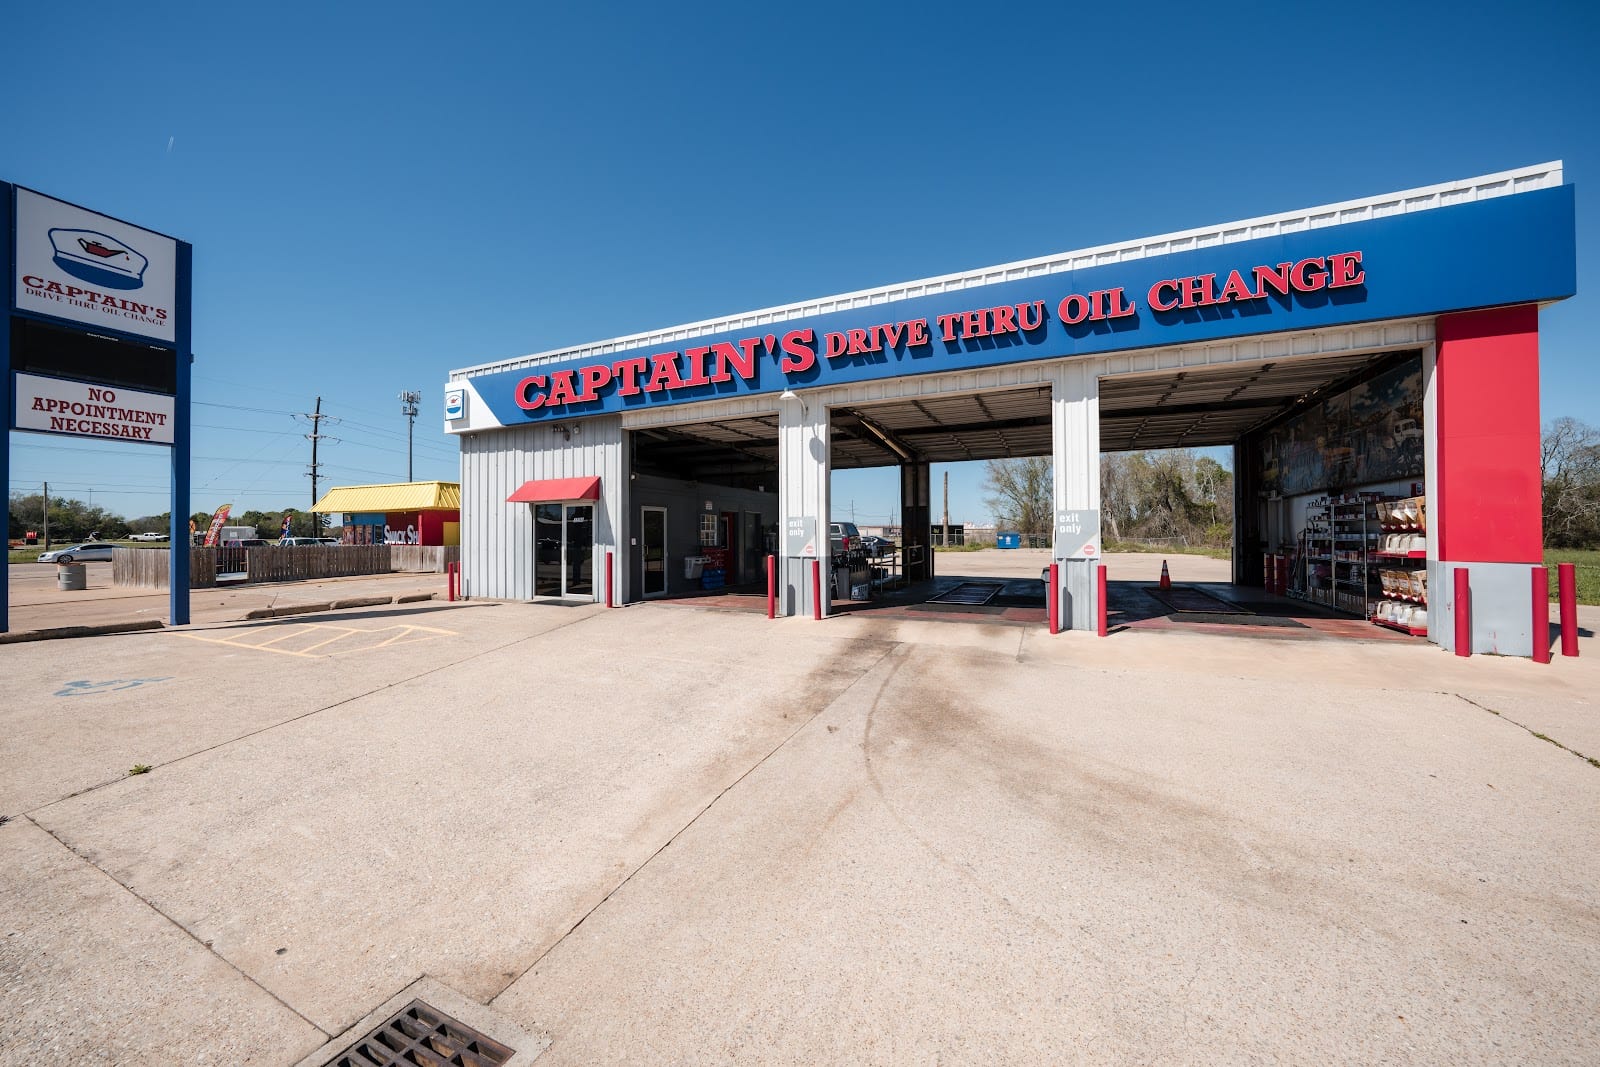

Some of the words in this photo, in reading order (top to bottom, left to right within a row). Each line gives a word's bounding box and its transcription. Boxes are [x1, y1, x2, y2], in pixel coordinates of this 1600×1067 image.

[22, 275, 168, 320] CAPTAIN'S
[26, 287, 64, 303] DRIVE
[68, 298, 98, 311] THRU
[102, 306, 121, 317] OIL
[124, 312, 166, 327] CHANGE
[515, 328, 816, 410] CAPTAIN'S
[823, 318, 928, 358] DRIVE
[937, 300, 1045, 341] THRU
[1057, 287, 1136, 325] OIL
[1147, 250, 1366, 312] CHANGE
[88, 387, 116, 403] NO
[31, 397, 167, 426] APPOINTMENT
[50, 416, 153, 439] NECESSARY
[789, 519, 803, 528] exit
[1059, 512, 1080, 523] exit
[789, 528, 804, 537] only
[1059, 523, 1081, 535] only
